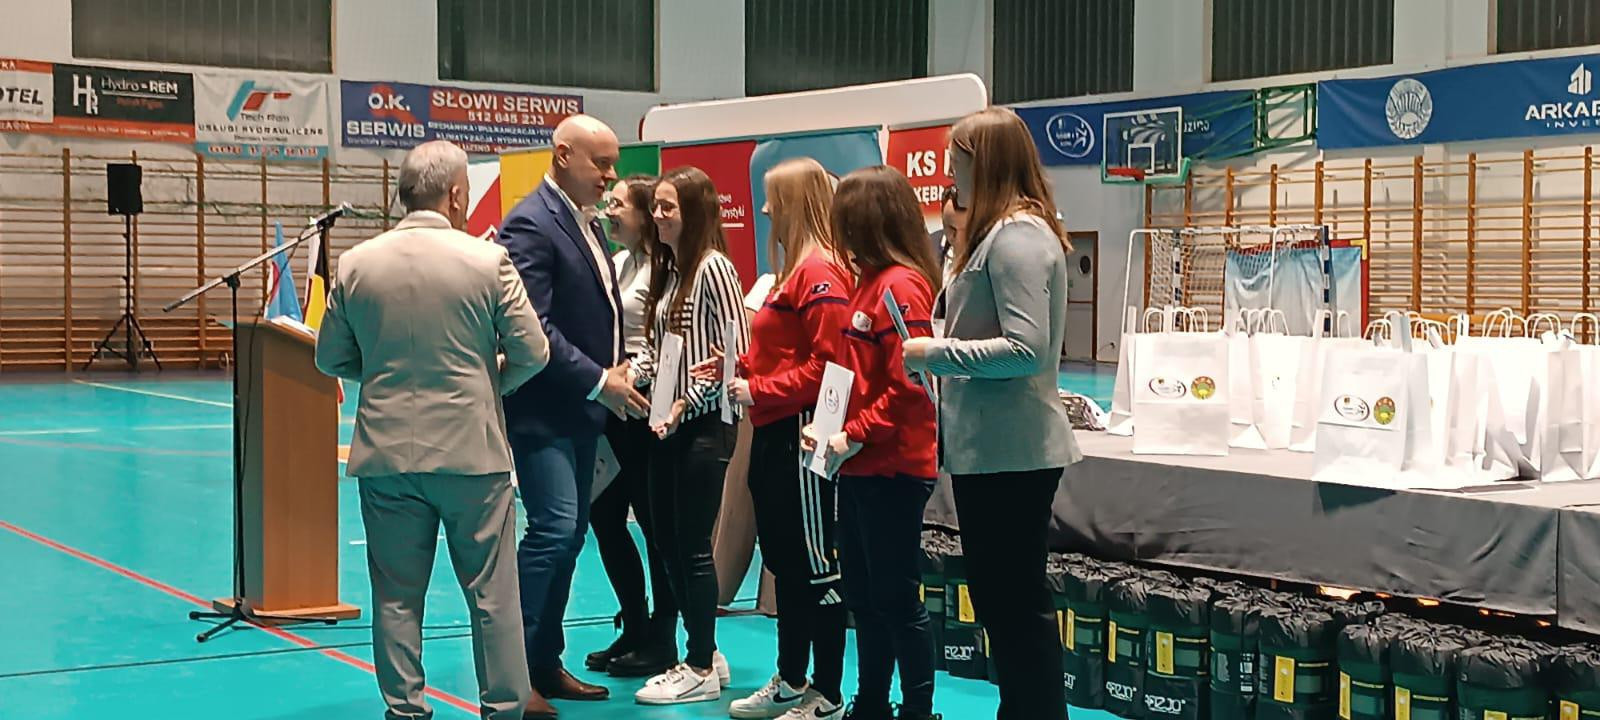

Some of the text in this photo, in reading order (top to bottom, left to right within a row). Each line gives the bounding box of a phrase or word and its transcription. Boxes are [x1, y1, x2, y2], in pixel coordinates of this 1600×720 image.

[149, 80, 178, 95] REM
[368, 92, 411, 111] O.K.
[432, 89, 579, 115] SŁOWI SERWIS
[346, 119, 426, 138] SERWIS
[906, 149, 937, 178] KS
